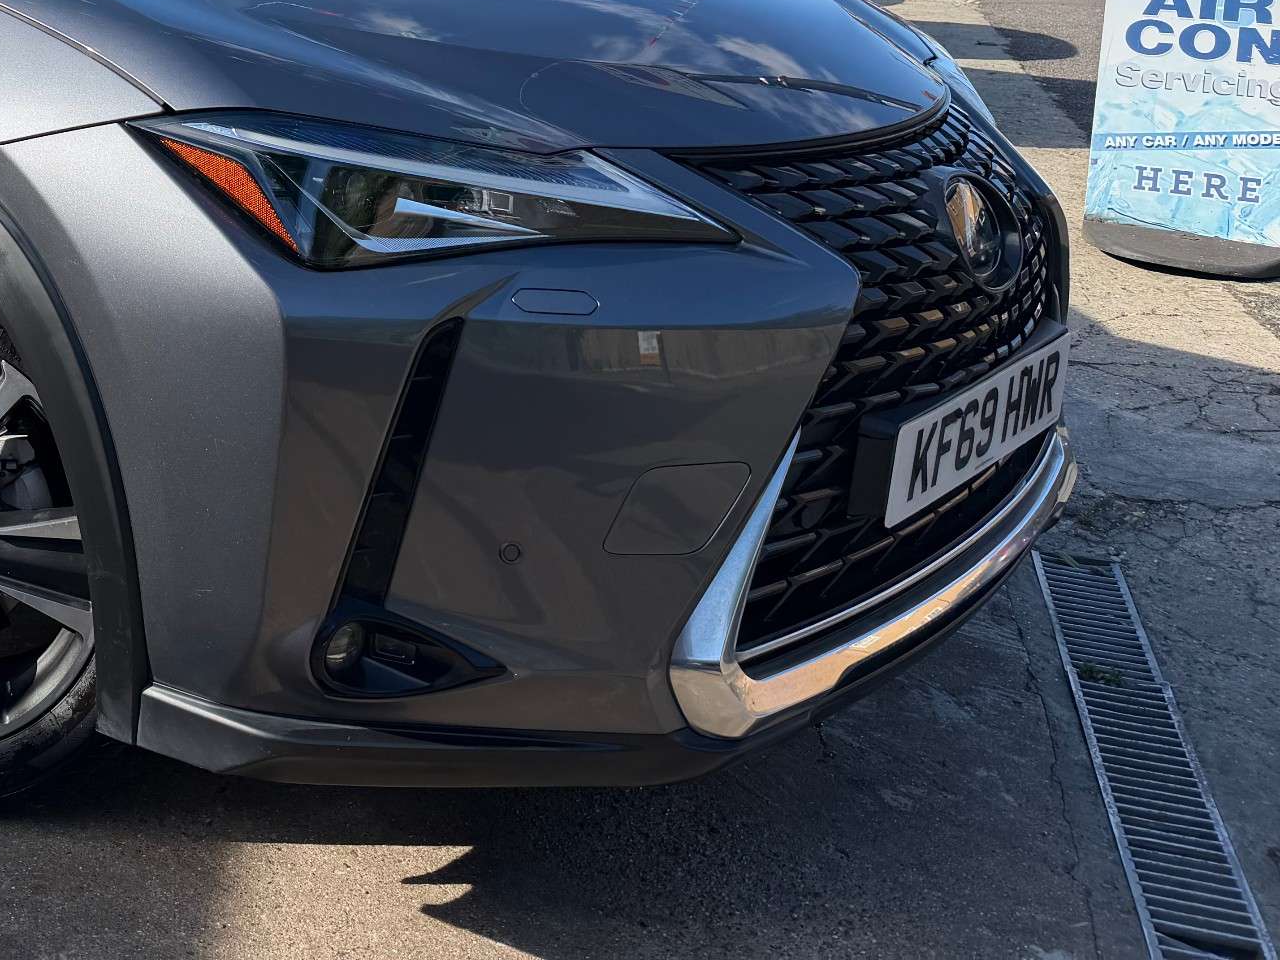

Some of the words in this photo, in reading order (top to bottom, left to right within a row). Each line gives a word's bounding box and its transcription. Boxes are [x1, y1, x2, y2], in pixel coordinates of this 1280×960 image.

[1125, 18, 1280, 65] CON
[1104, 136, 1138, 149] ANY
[1142, 136, 1177, 148] CAR
[1193, 134, 1227, 147] ANY
[1133, 165, 1262, 203] HERE
[906, 386, 999, 504] KF69
[1000, 350, 1061, 444] HWR
